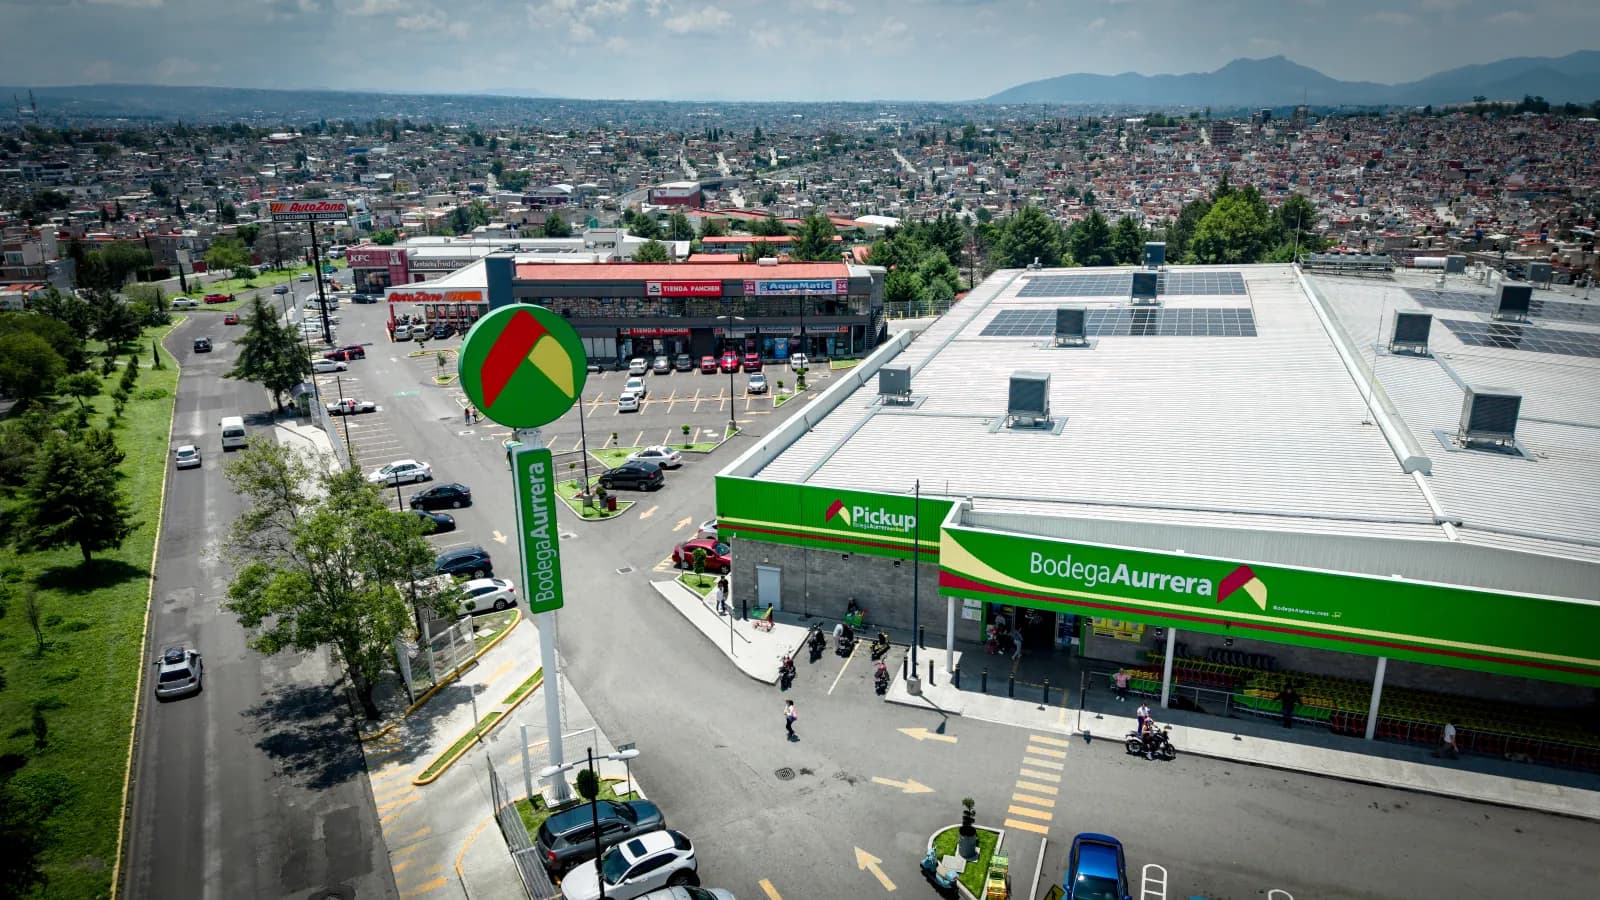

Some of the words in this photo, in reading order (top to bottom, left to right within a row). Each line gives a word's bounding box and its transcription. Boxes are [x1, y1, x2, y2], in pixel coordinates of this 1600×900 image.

[290, 202, 345, 212] AutoZone
[350, 254, 369, 262] KFC
[769, 281, 831, 290] AquaMatic
[388, 292, 443, 302] AutoZone
[852, 505, 917, 533] Pickup
[1030, 551, 1212, 597] BodegaAurrera
